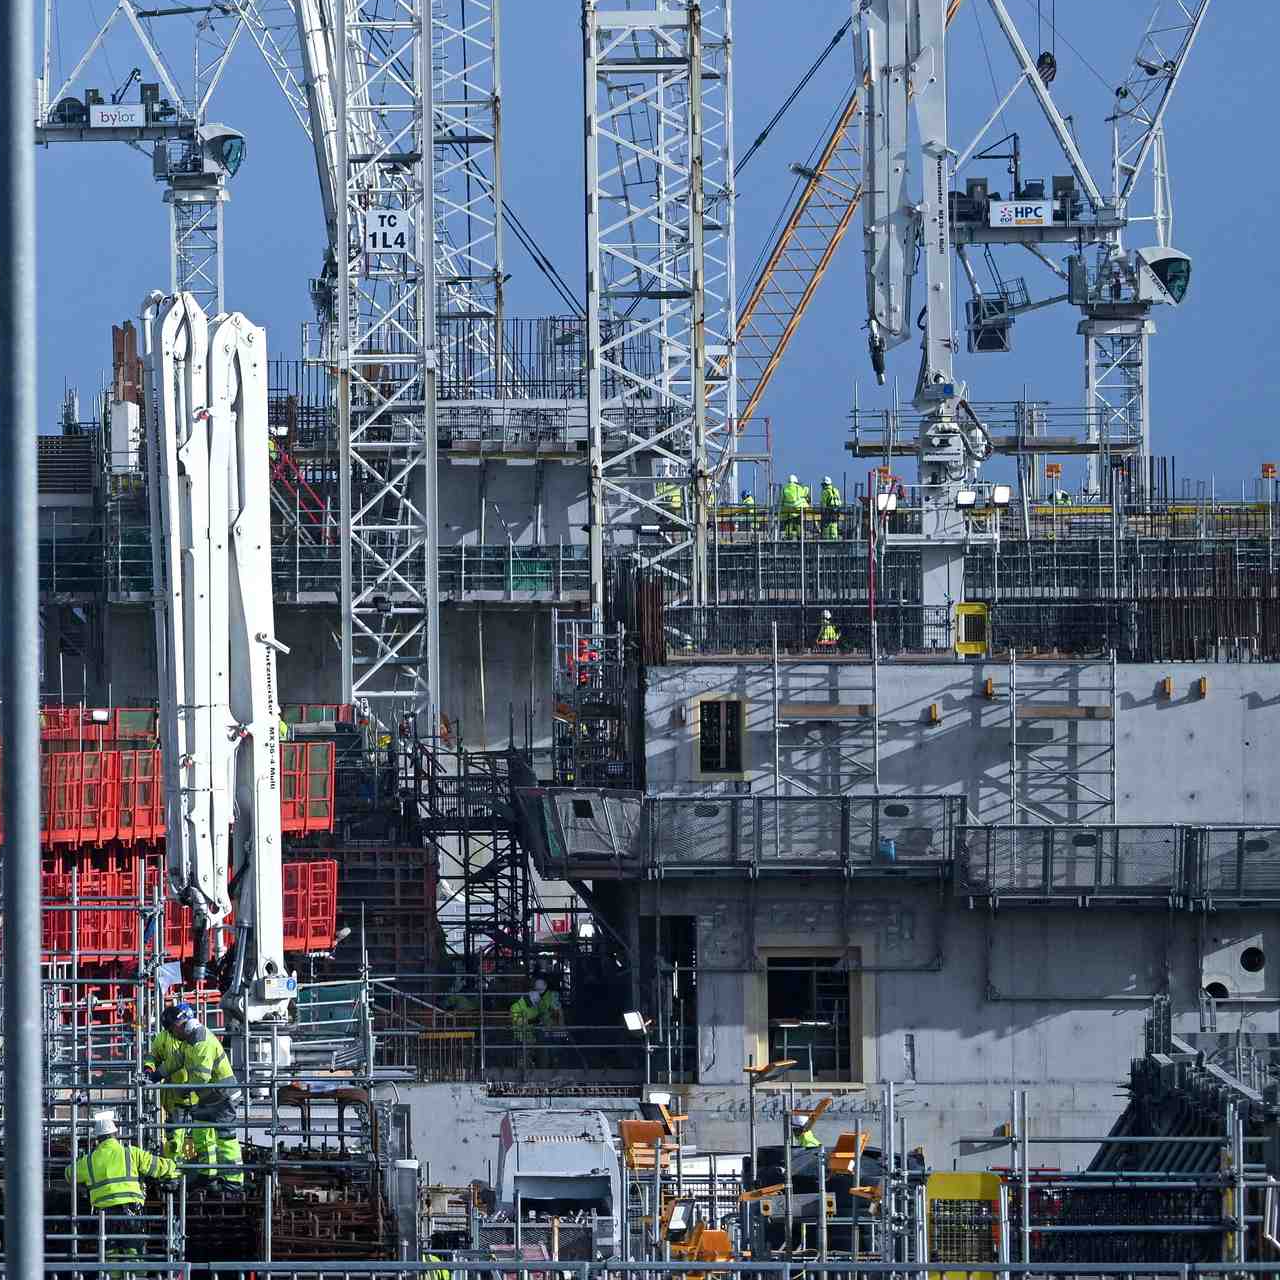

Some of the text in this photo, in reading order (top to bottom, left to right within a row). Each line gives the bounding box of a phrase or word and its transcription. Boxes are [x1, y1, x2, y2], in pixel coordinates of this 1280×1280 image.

[100, 110, 136, 125] bylor
[1014, 206, 1043, 218] HPC
[378, 214, 397, 228] TC
[368, 231, 406, 249] 1L4
[265, 646, 273, 716] Putzmeister
